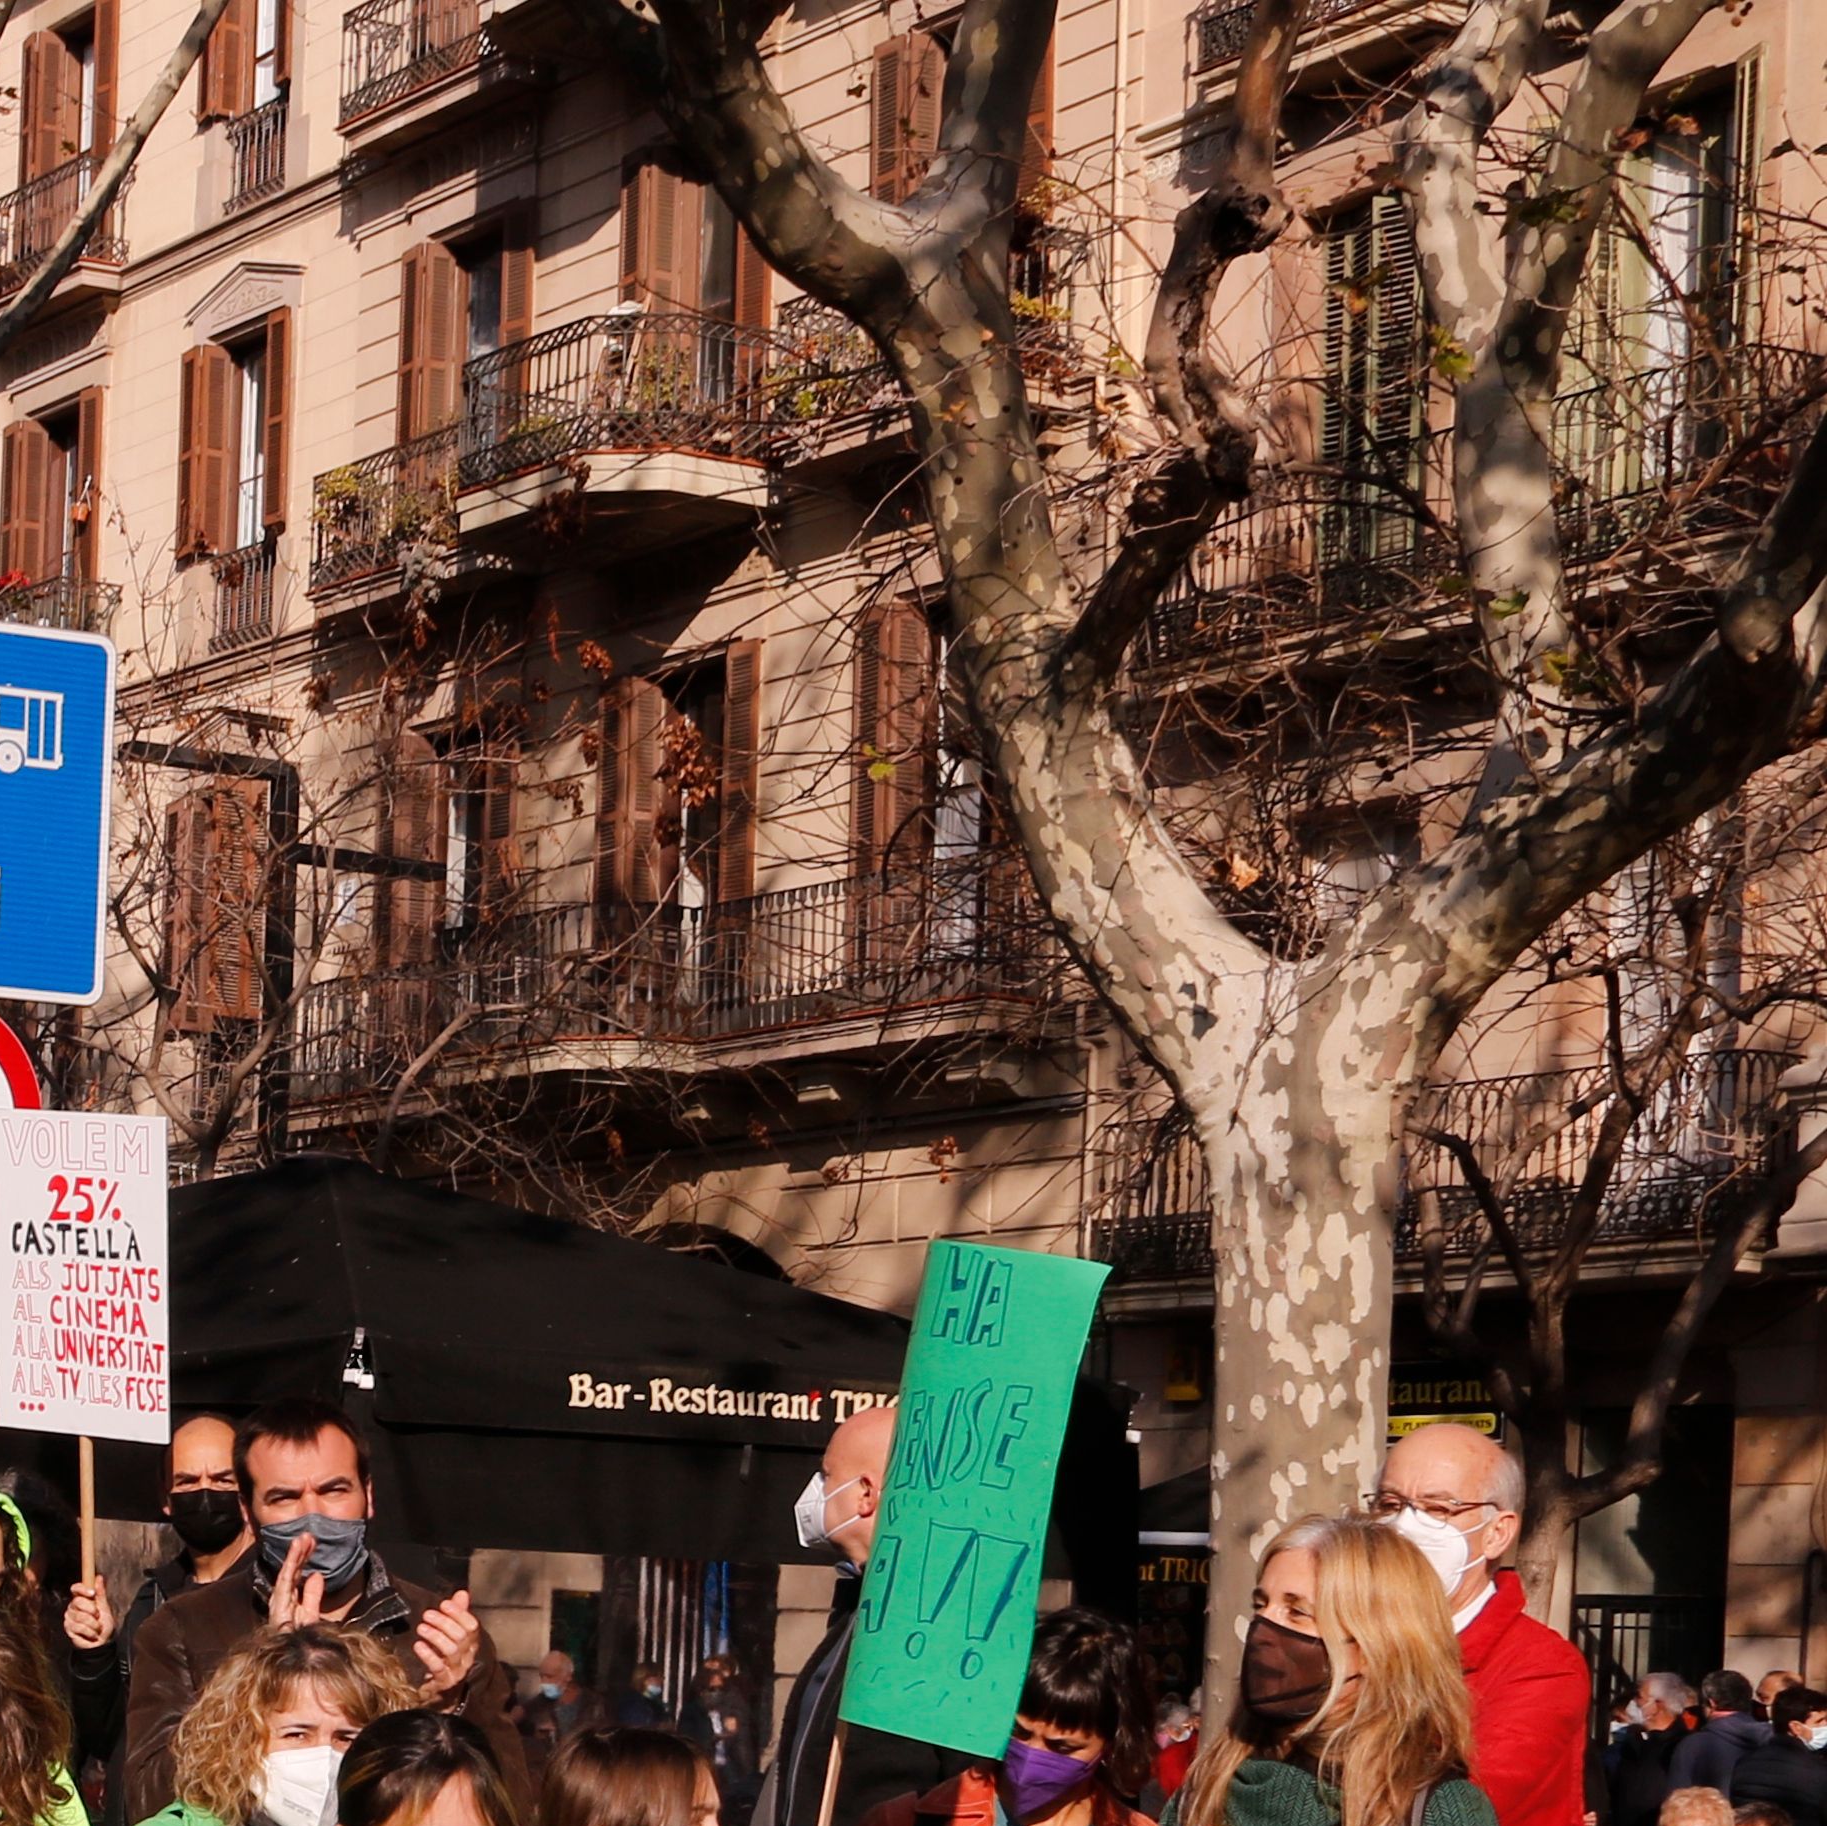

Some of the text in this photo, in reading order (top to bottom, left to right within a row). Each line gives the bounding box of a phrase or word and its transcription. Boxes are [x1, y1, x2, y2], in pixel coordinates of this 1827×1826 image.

[1, 1118, 150, 1175] VOLEM
[47, 1174, 122, 1223] 25%
[12, 1221, 142, 1261] CASTELLÀ
[12, 1260, 52, 1290] ALS
[13, 1294, 148, 1338] AL CINEMA
[53, 1331, 166, 1375] UNIVERSITAT
[88, 1373, 122, 1408] LES
[125, 1377, 167, 1412] FCSE
